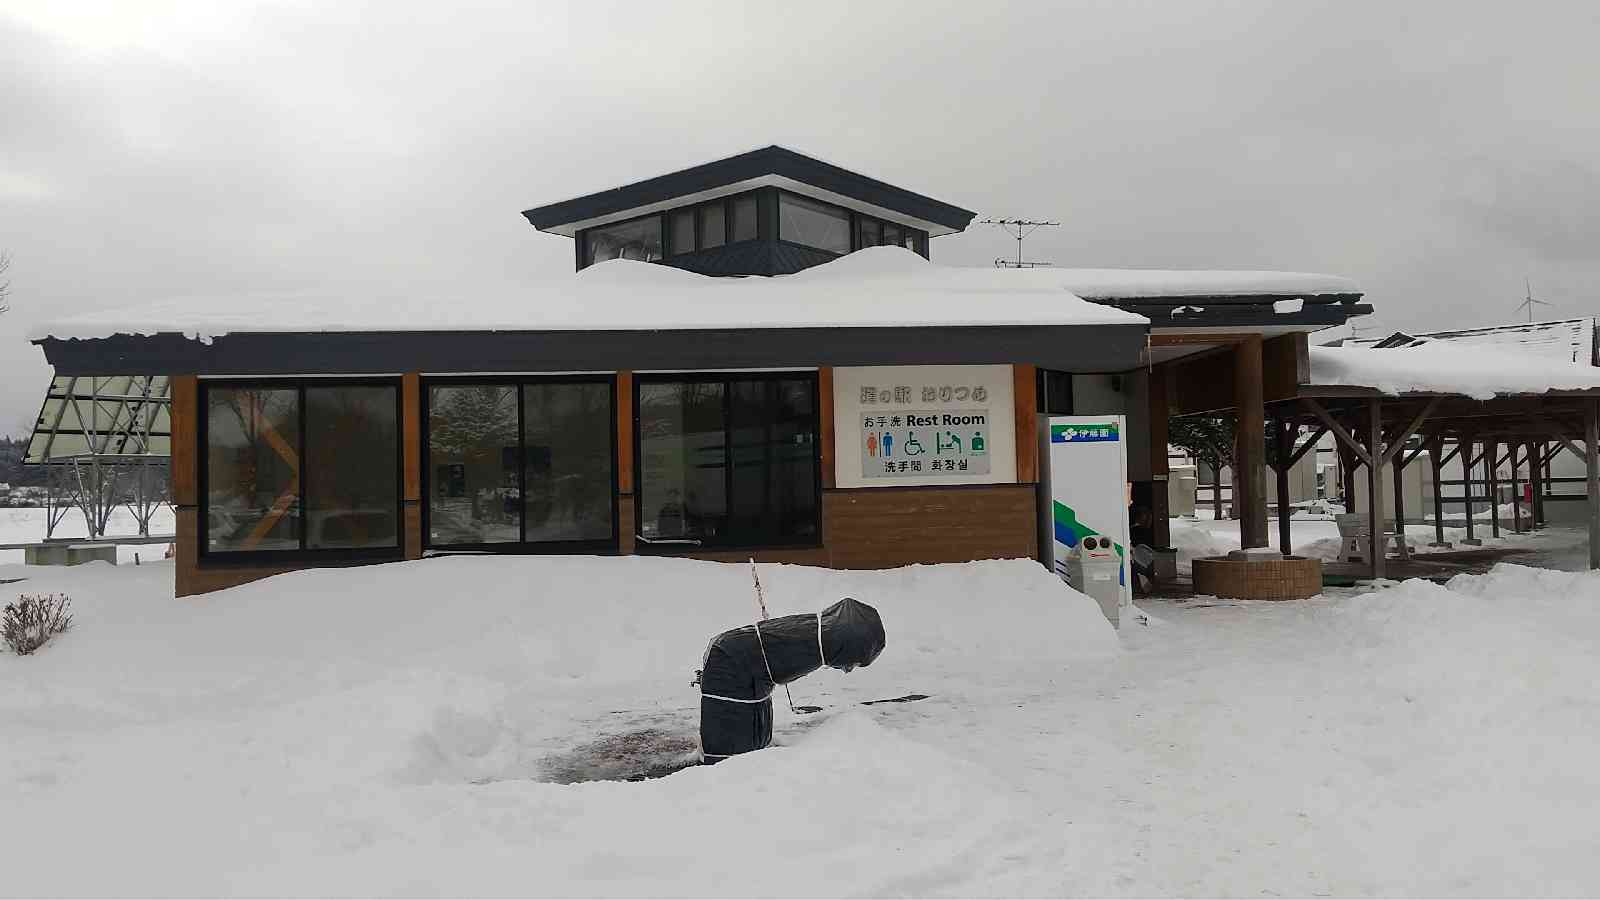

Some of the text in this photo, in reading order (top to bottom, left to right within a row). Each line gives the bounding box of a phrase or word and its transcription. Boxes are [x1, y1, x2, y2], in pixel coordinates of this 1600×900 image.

[864, 414, 985, 428] お手洗 Rest Room
[885, 459, 968, 473] 洗手間 화장실
